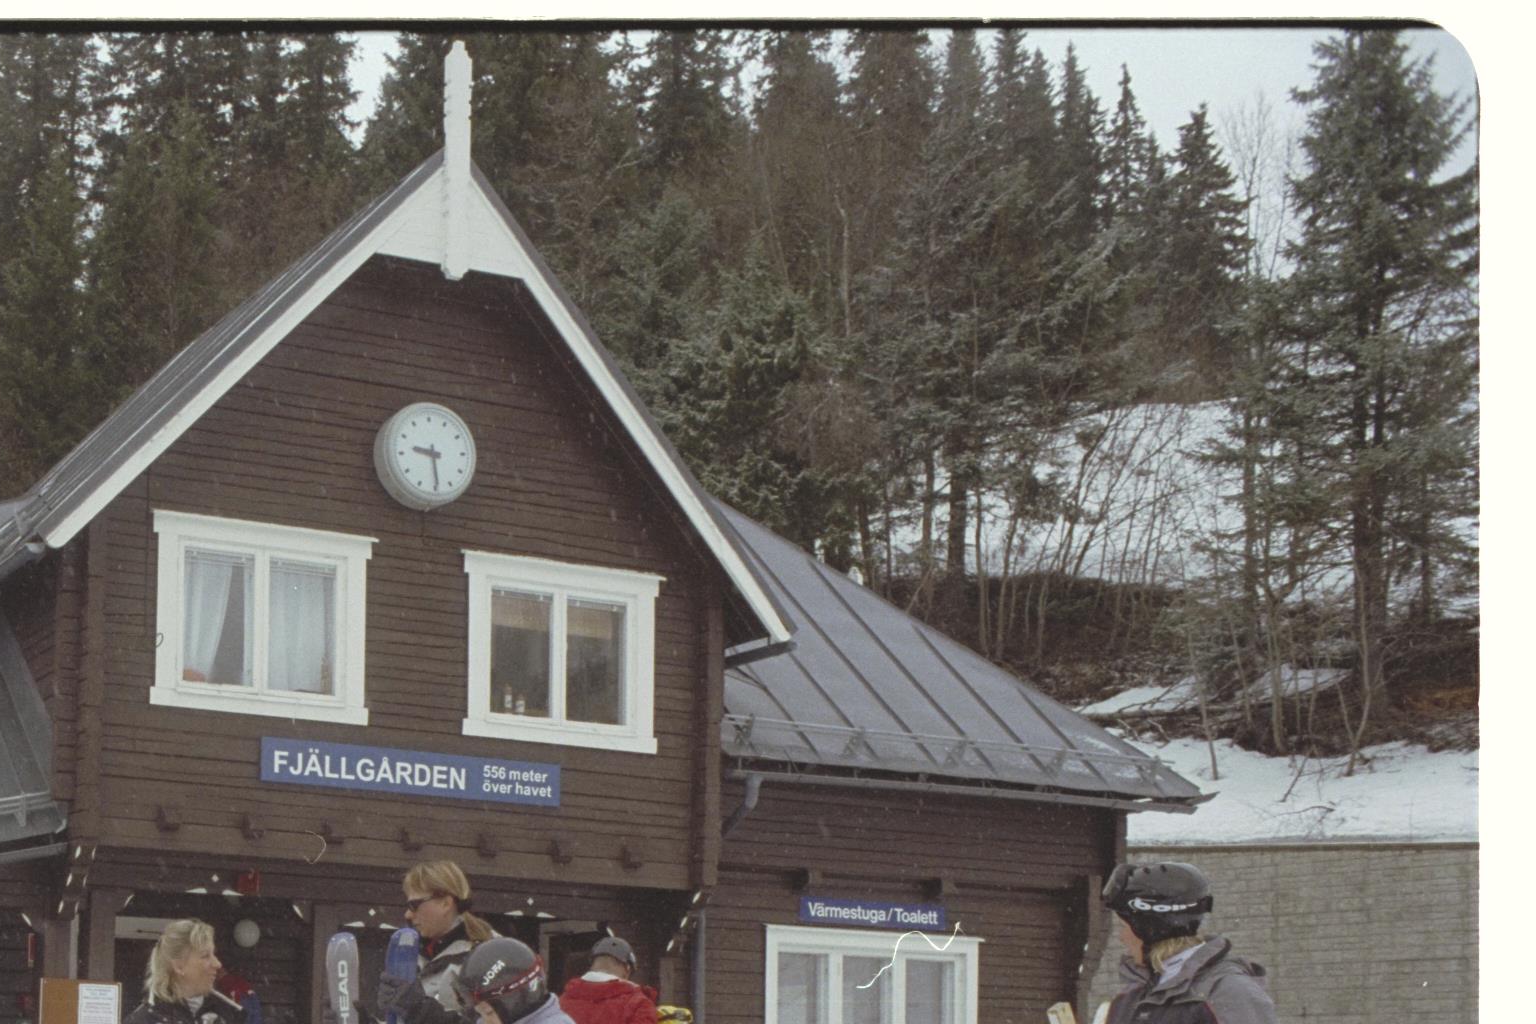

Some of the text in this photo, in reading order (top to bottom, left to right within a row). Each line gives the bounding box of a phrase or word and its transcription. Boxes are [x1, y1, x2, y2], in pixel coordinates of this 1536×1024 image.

[272, 747, 467, 790] FJÄLLGÅRDEN
[482, 764, 549, 783] 556 meter
[482, 780, 553, 799] över havet
[482, 959, 506, 986] JOFA
